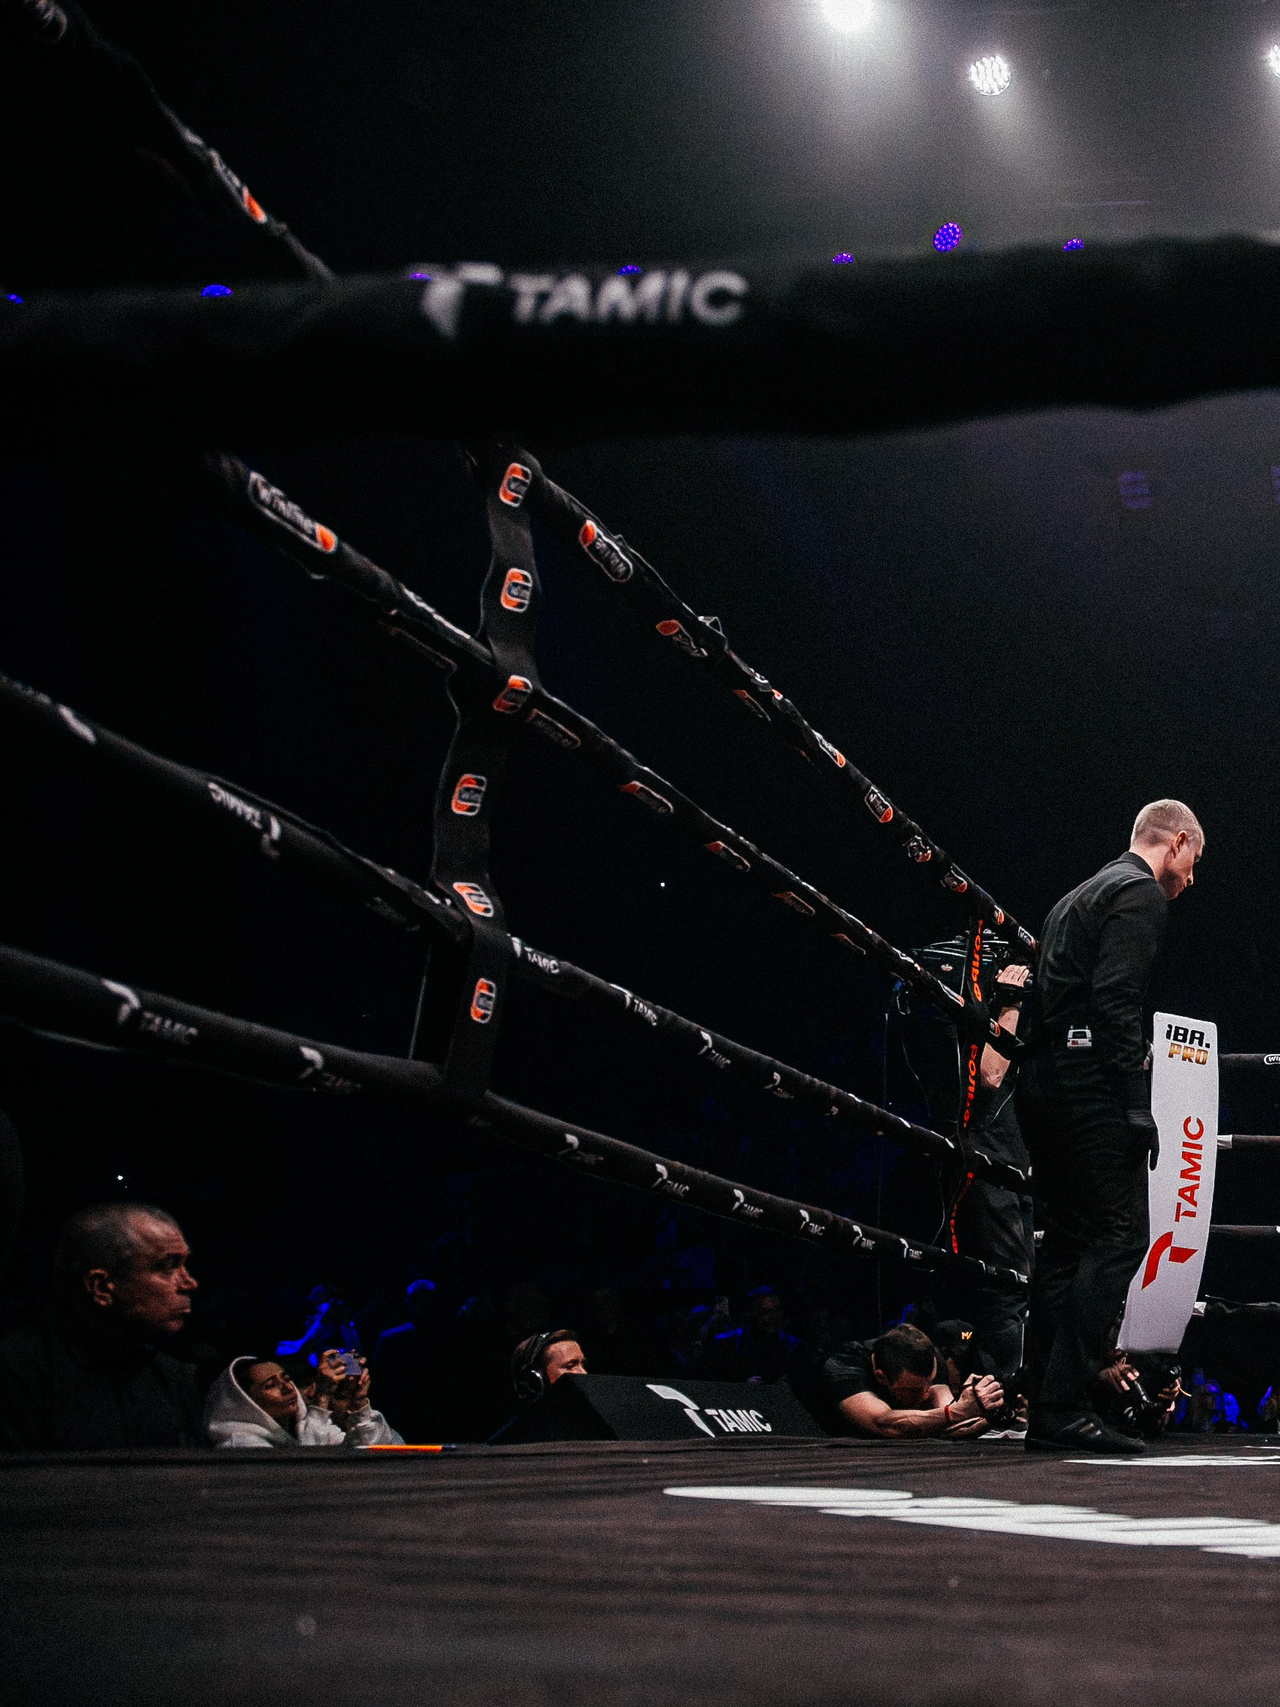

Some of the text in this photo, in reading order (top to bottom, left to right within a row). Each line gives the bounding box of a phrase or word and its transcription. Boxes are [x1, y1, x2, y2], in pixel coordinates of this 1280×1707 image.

[508, 271, 749, 326] TAMIC
[1168, 1043, 1209, 1065] PRO
[1175, 1115, 1205, 1223] TAMIC
[704, 1408, 772, 1433] TAMIC
